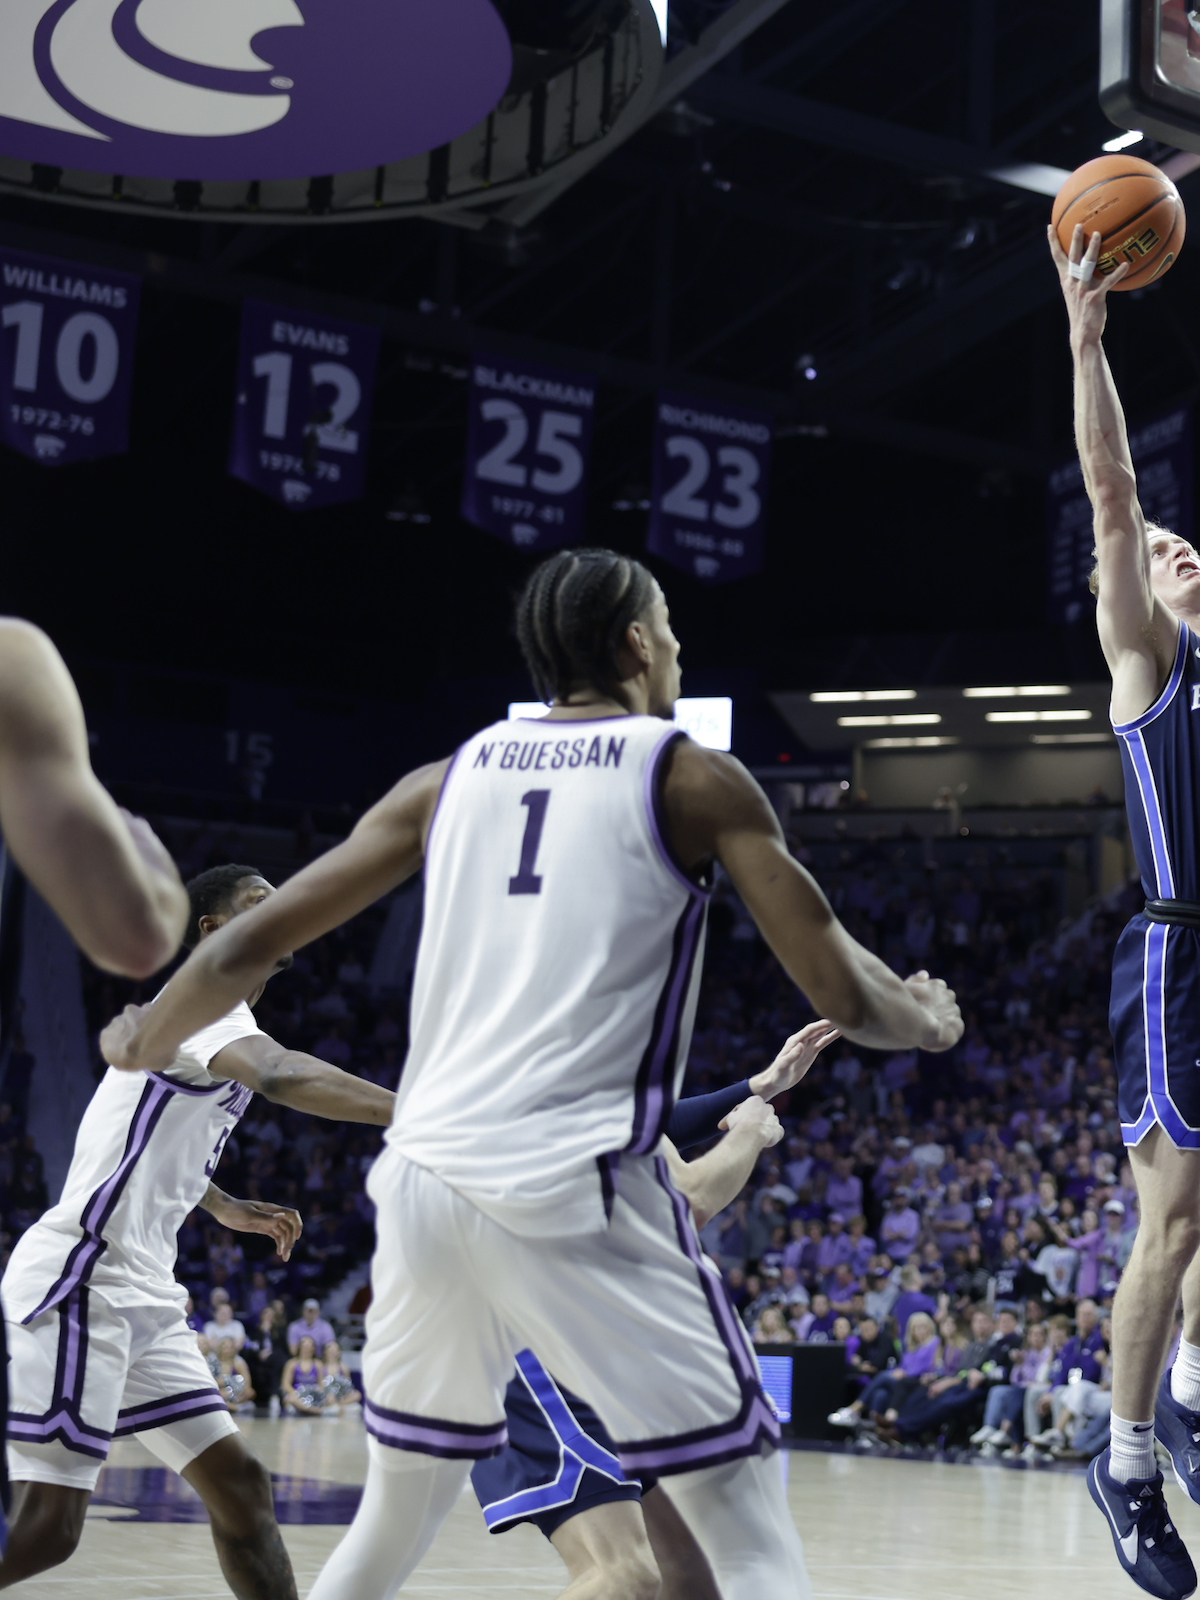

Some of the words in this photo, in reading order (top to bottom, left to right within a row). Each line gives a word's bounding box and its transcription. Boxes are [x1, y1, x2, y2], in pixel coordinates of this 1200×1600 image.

[2, 263, 128, 309] WILLIAMS
[1, 300, 120, 404] 10
[271, 320, 350, 357] EVANS
[252, 351, 362, 455] 12
[474, 364, 594, 408] BLACKMAN
[11, 404, 95, 436] 1972-76
[658, 403, 770, 445] RICHMOND
[259, 449, 341, 483] 197478
[475, 398, 584, 495] 25
[660, 435, 761, 529] 23
[491, 496, 565, 525] 1977-81
[472, 735, 627, 770] N'GUESSAN
[508, 788, 551, 896] 1
